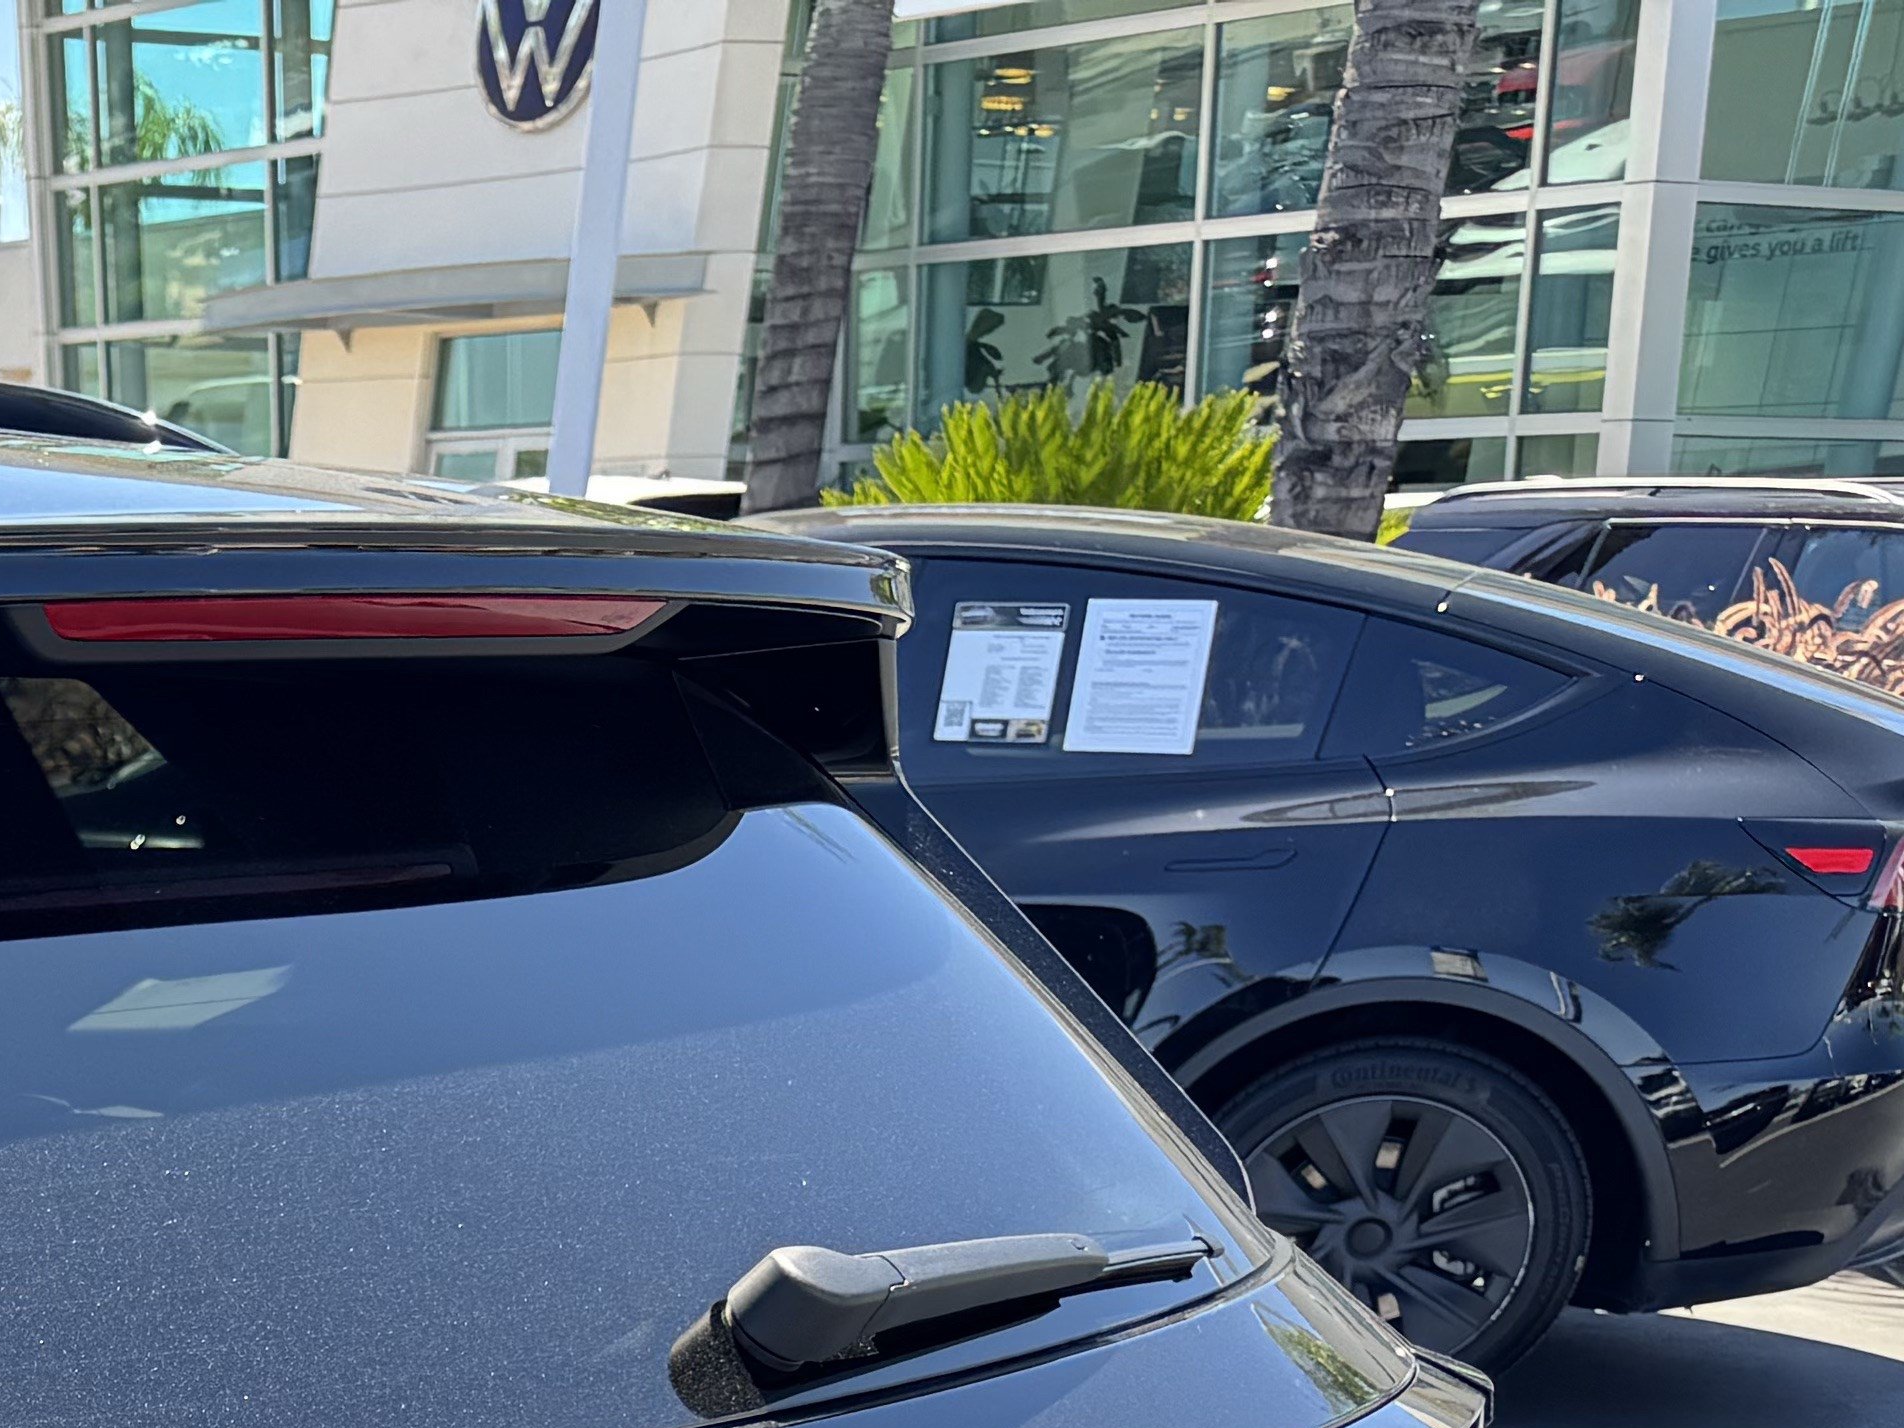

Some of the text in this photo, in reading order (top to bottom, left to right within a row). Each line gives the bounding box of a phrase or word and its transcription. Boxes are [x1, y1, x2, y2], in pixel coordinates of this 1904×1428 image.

[1706, 241, 1761, 265] gives
[1766, 239, 1808, 261] you
[1811, 237, 1824, 252] a
[1829, 230, 1860, 252] lift
